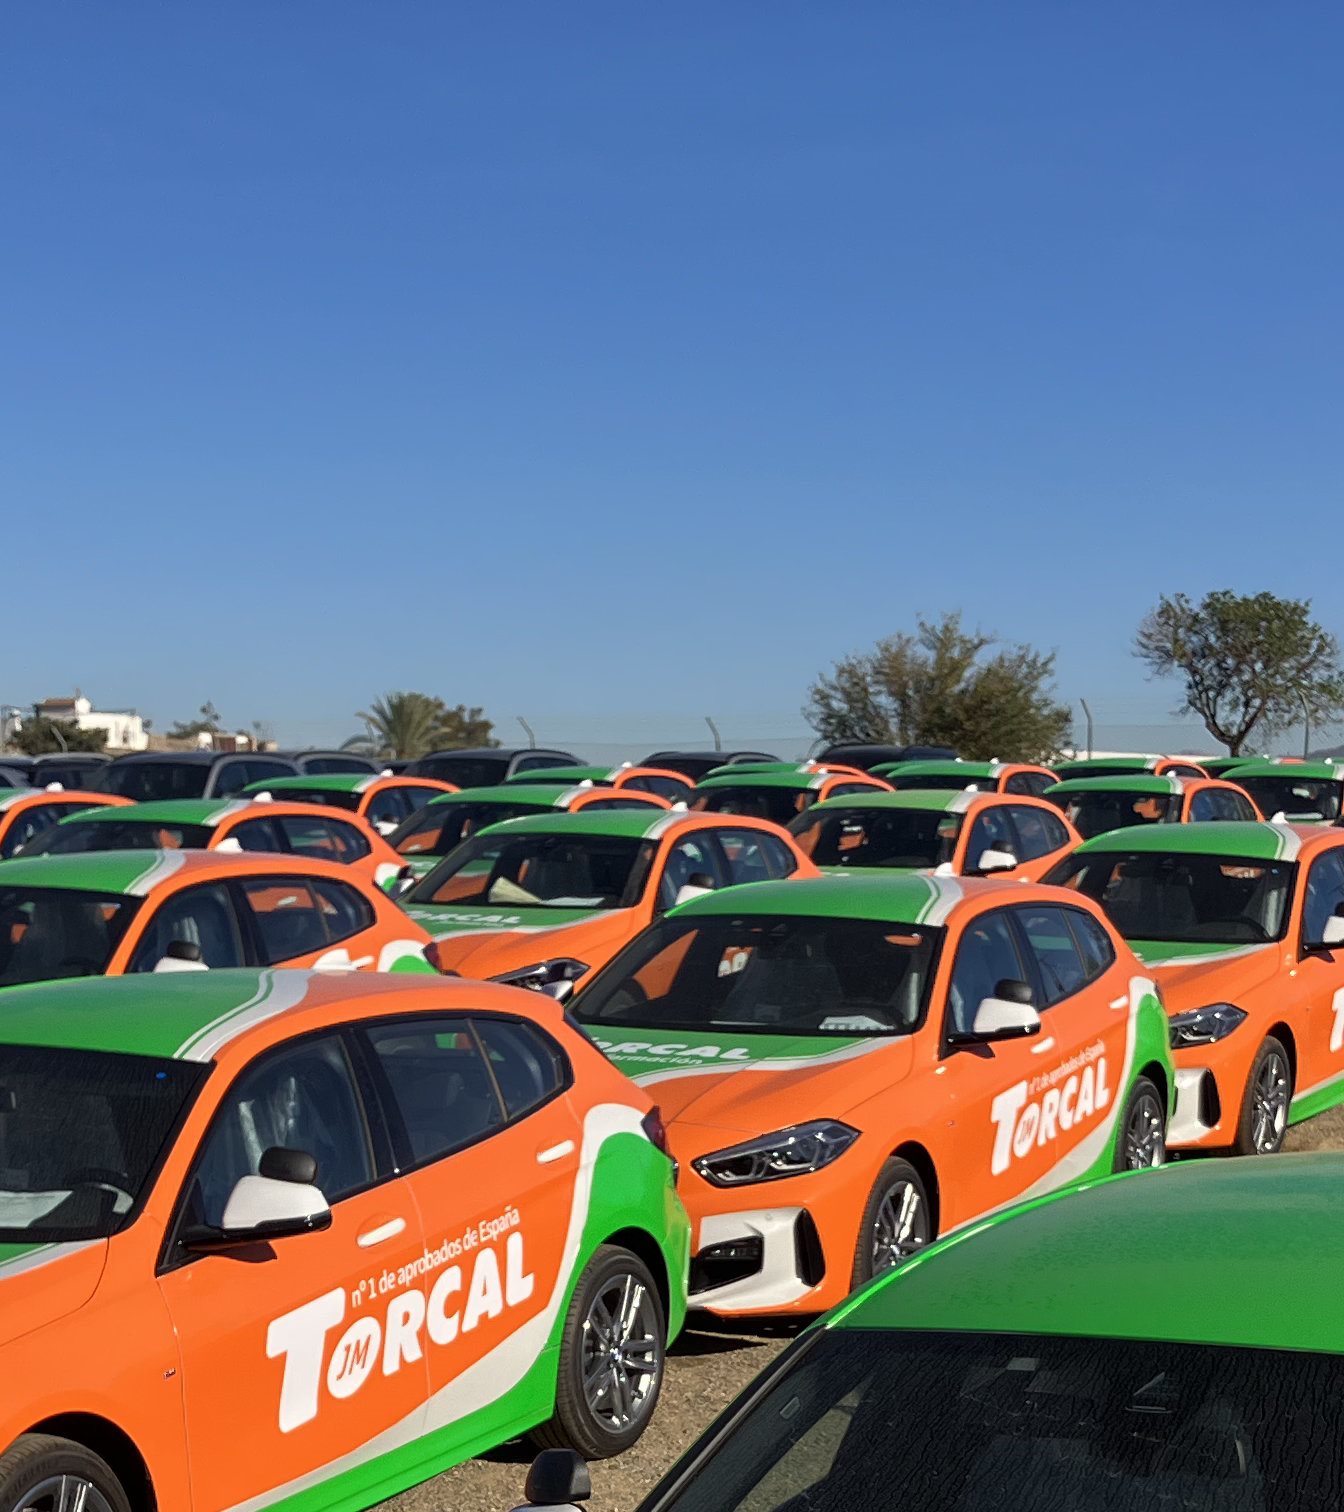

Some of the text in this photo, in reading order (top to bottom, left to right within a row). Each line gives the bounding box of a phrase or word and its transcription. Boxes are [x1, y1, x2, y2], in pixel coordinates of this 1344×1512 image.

[991, 1057, 1110, 1177] TORCAL
[378, 1269, 396, 1294] de
[397, 1238, 463, 1288] aprobados
[463, 1227, 479, 1251] de
[479, 1205, 520, 1243] España
[266, 1231, 534, 1434] TORCAL
